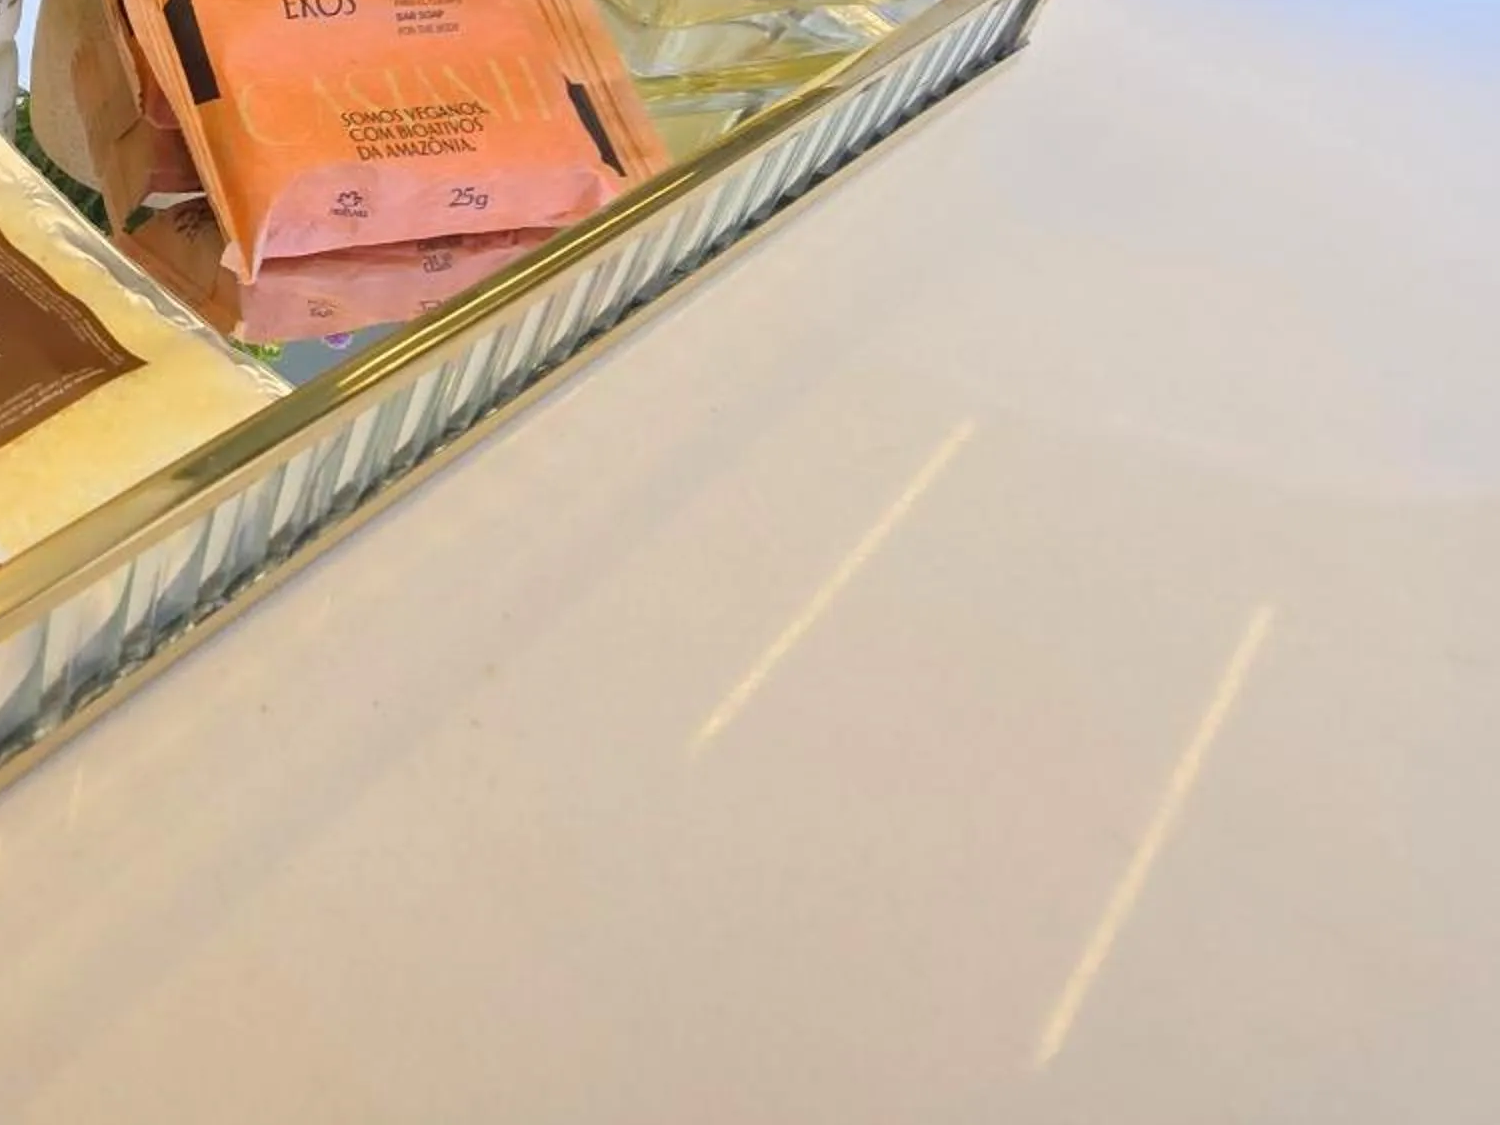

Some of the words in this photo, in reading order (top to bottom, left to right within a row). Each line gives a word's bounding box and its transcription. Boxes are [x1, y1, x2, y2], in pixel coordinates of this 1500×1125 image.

[341, 108, 404, 127] SOMOS
[349, 125, 396, 143] COM
[396, 116, 485, 140] BIOATIVOS
[356, 143, 384, 161] DA
[449, 187, 490, 210] 25g
